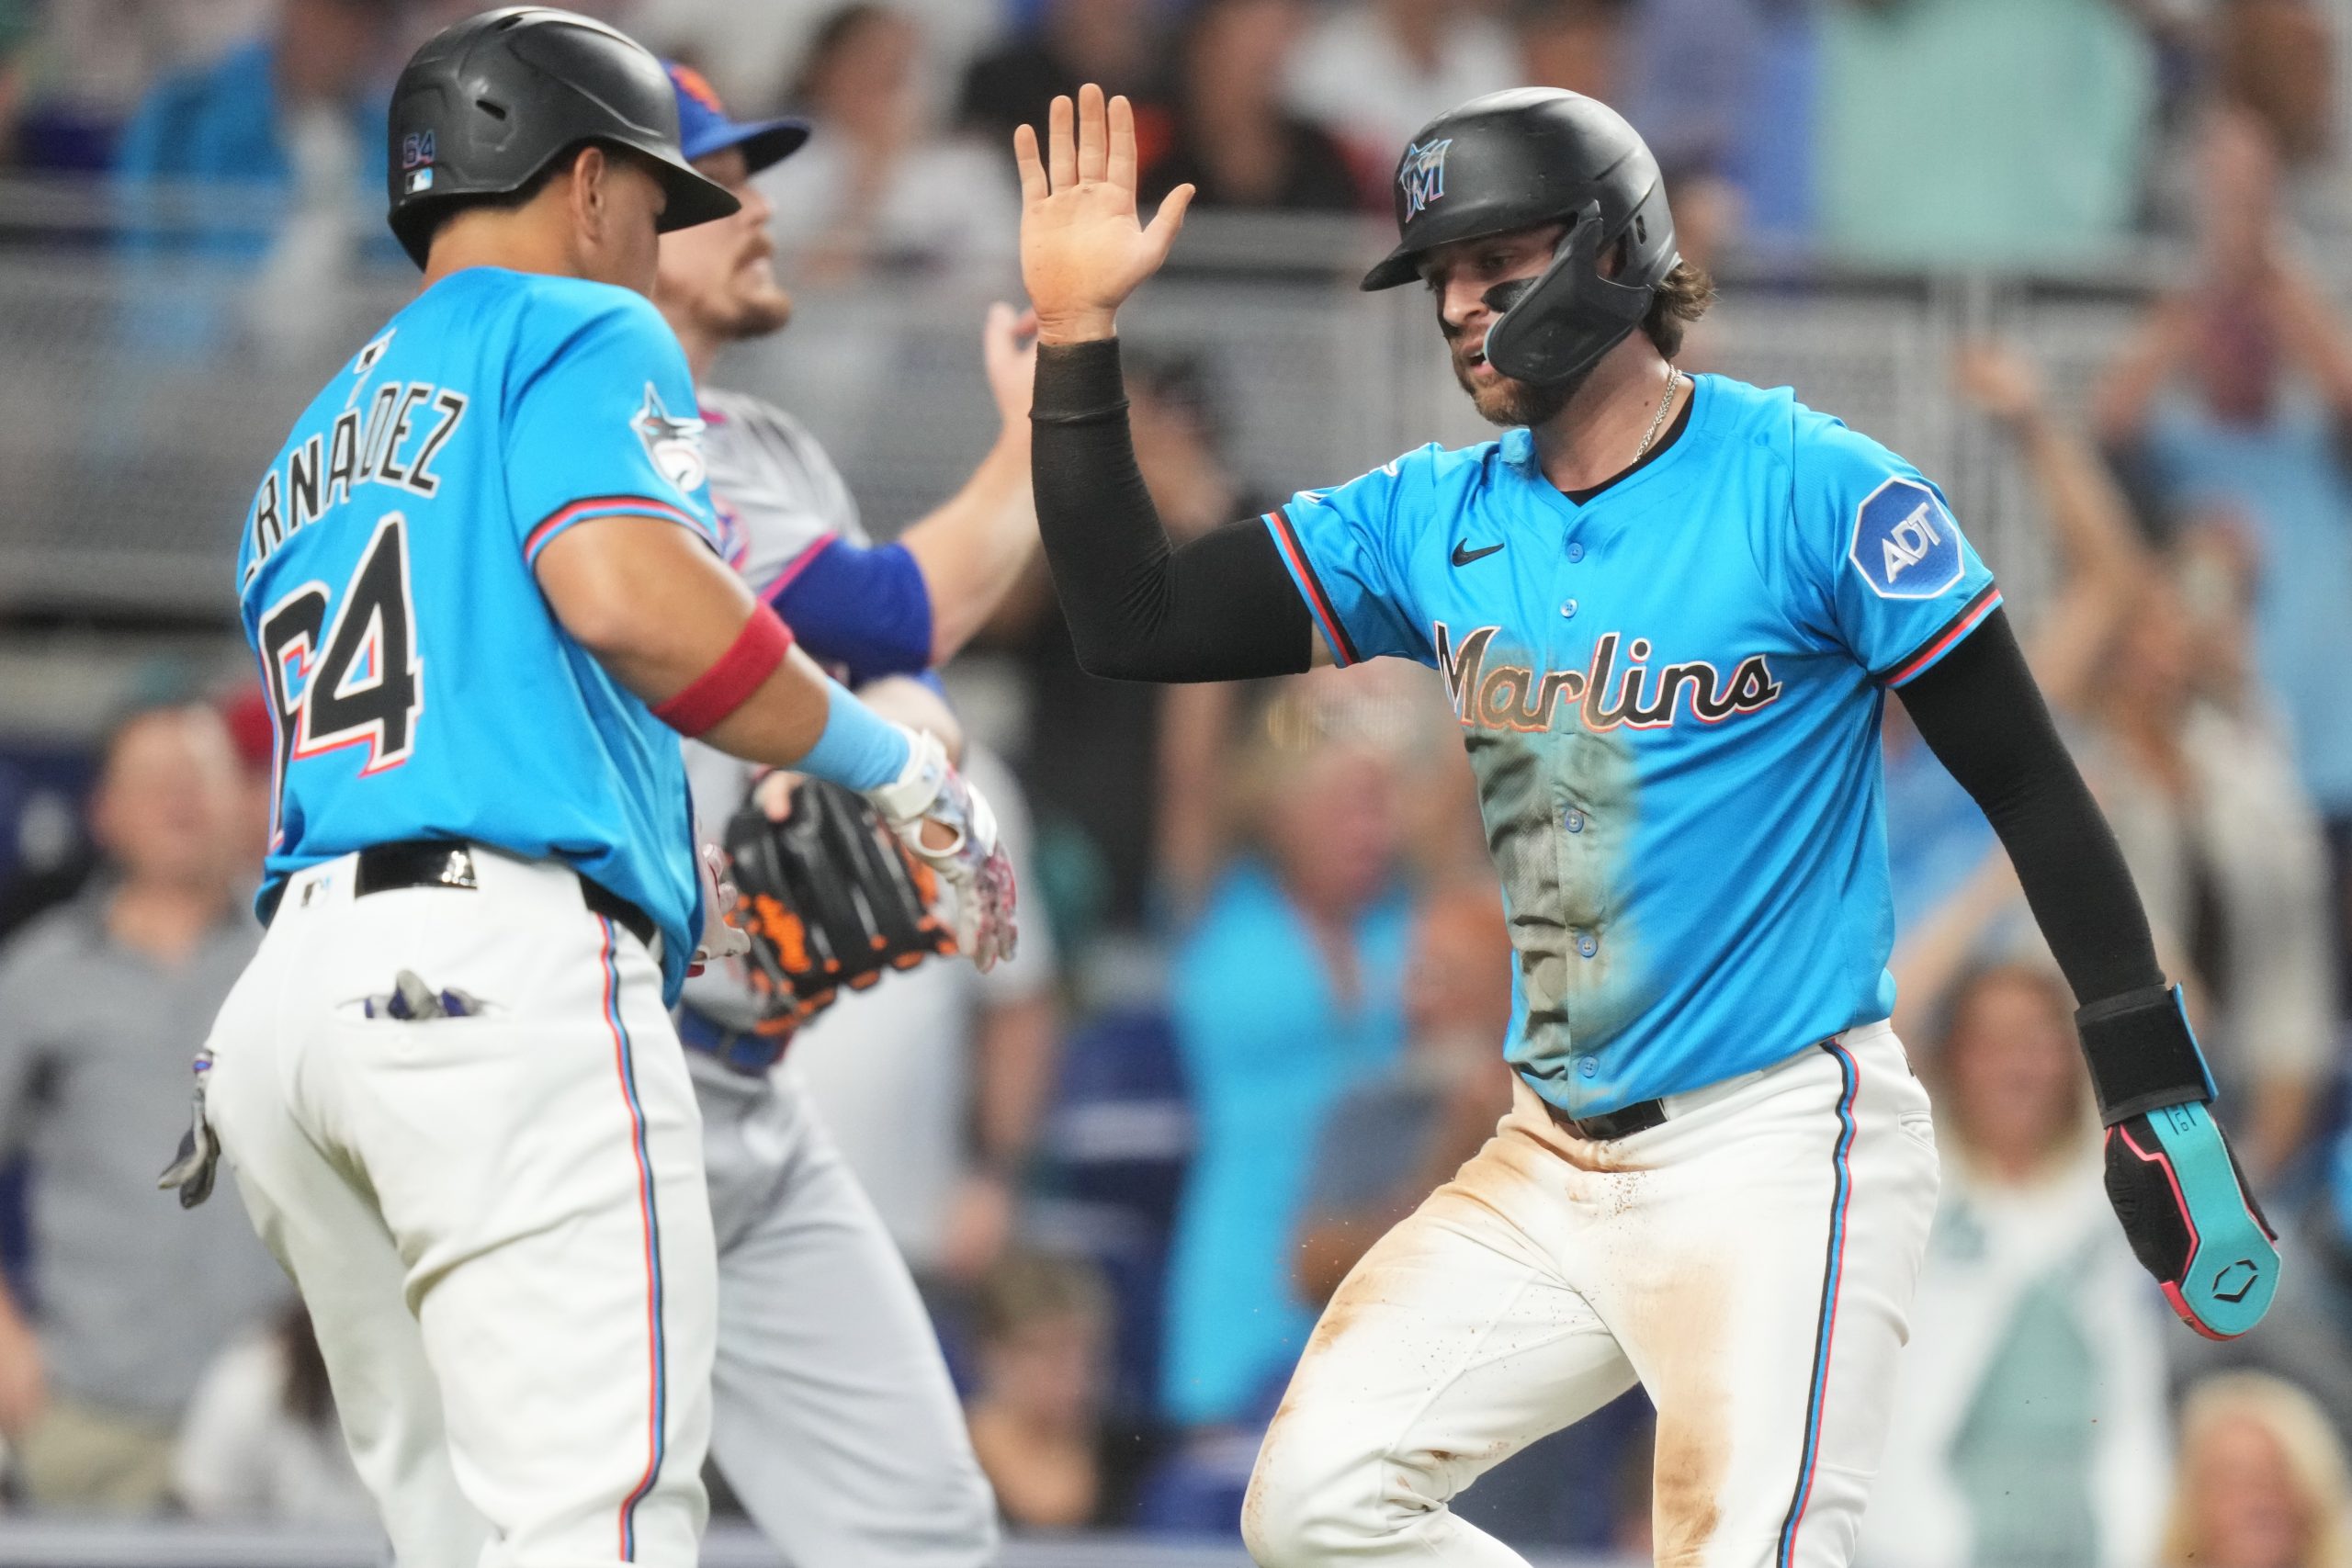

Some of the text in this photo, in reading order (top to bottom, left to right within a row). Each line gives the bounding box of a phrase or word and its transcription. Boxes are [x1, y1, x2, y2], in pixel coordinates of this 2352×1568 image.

[402, 130, 435, 169] 64
[1882, 502, 1941, 584] ADT
[1433, 620, 1782, 733] Marlins
